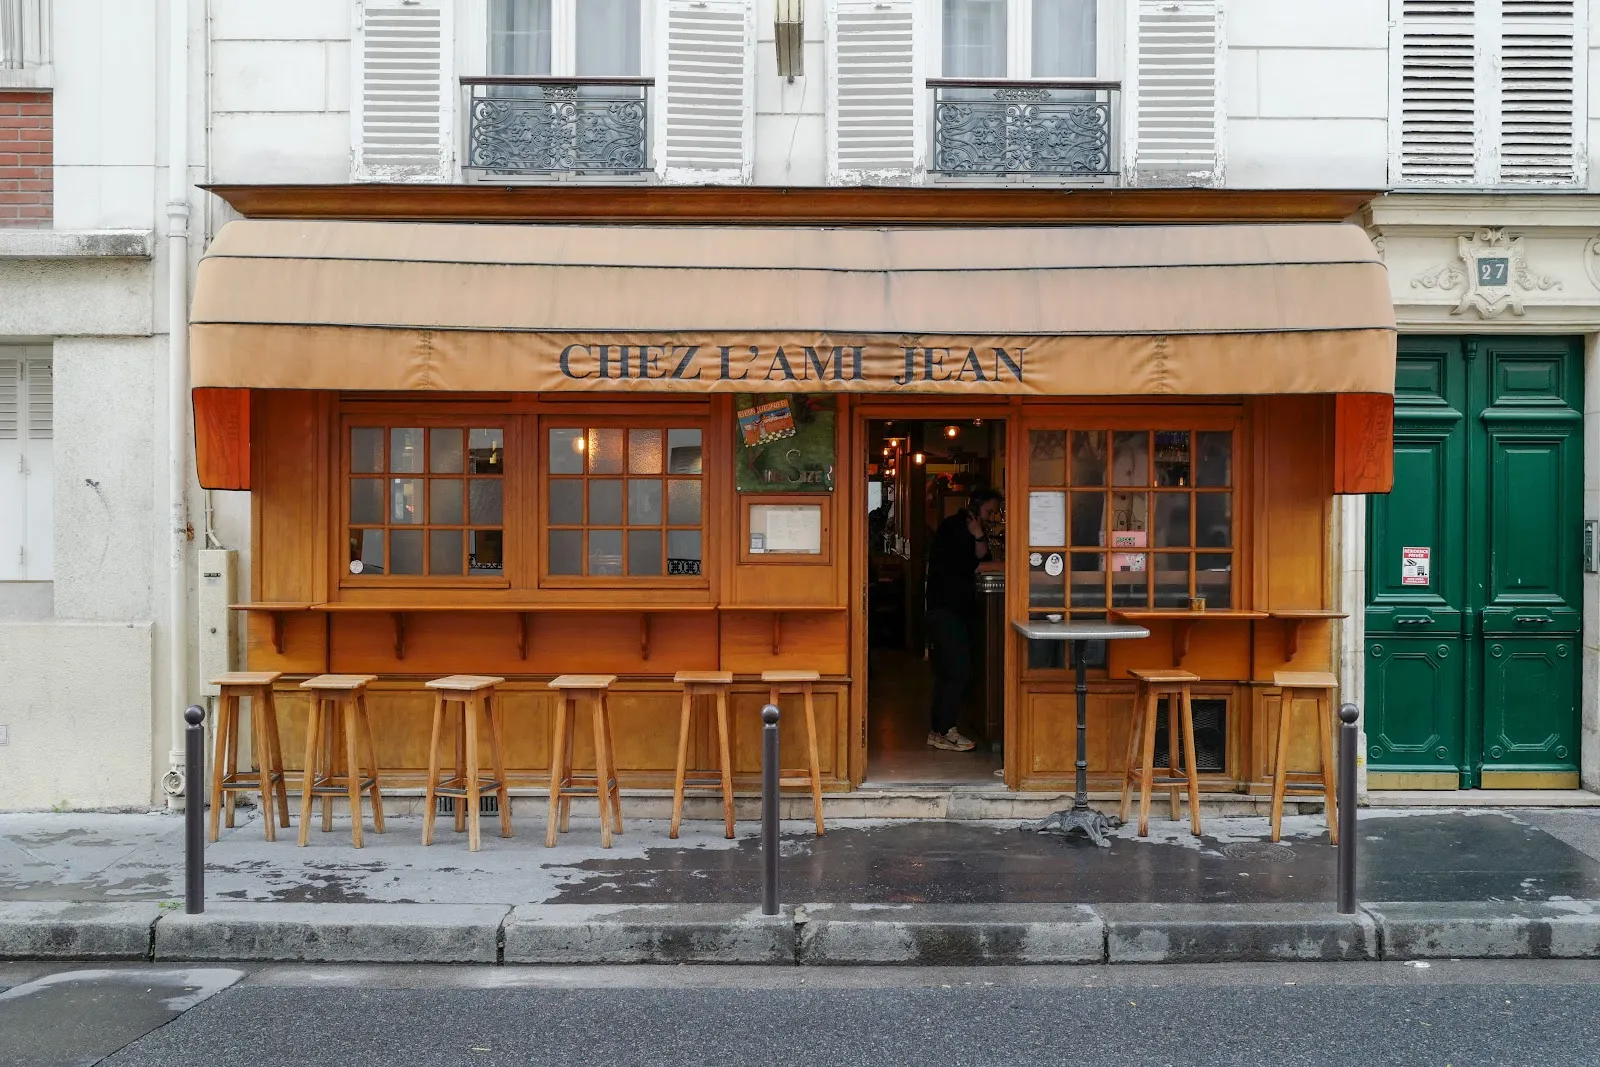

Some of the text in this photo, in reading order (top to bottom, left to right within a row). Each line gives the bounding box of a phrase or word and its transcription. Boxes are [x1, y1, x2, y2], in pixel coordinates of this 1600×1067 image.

[1481, 263, 1505, 280] 27
[559, 343, 1028, 386] CHEZ L'AMI JEAN
